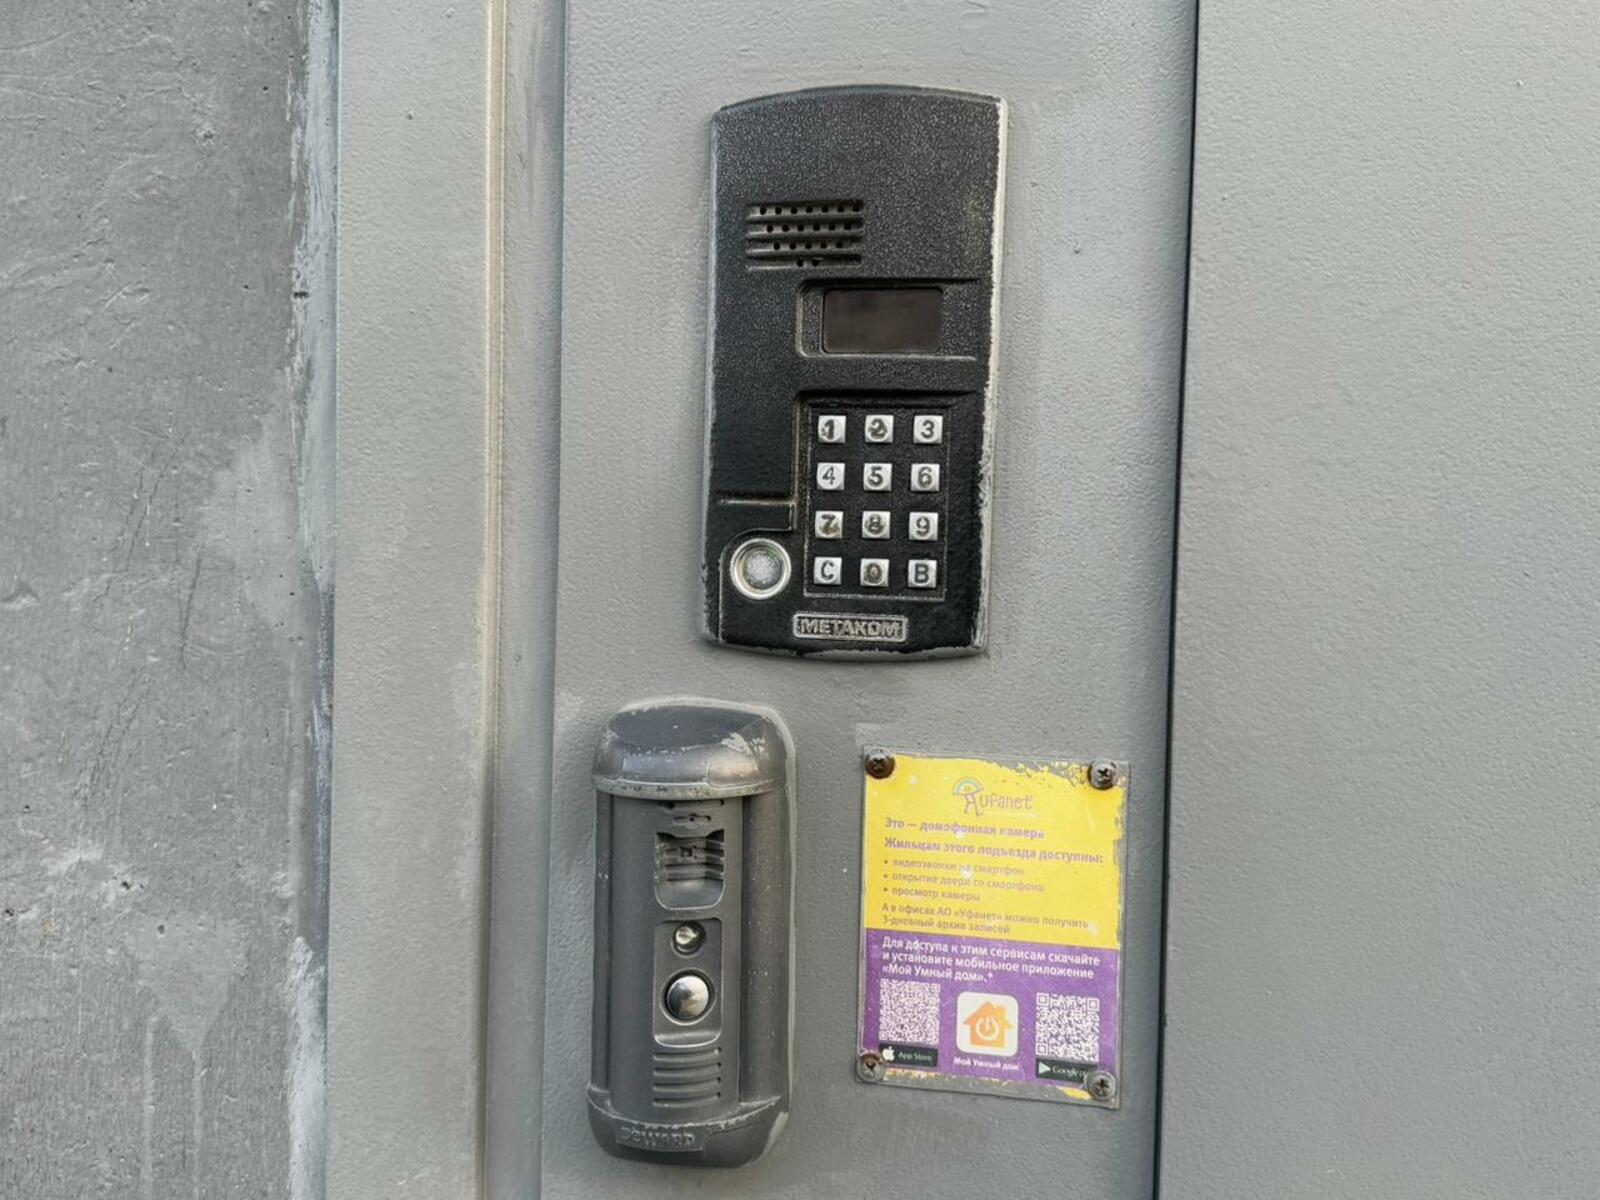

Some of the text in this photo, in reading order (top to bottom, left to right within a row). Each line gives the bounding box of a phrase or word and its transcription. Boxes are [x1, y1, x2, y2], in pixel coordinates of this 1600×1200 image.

[824, 419, 934, 440] 1 2 3
[822, 466, 932, 488] 4 5 6
[821, 514, 930, 537] 7 8 9
[821, 560, 834, 580] C
[885, 817, 904, 828] Это
[884, 838, 941, 852] Жильцам
[944, 843, 975, 855] этого
[978, 847, 1037, 859] подъезда
[892, 887, 939, 899] просмотр
[899, 904, 935, 917] офисах
[969, 921, 1010, 934] записей
[883, 936, 1100, 966] Для доступа к этим сервисам скачайте
[883, 952, 1094, 979] и установите мобильное приложение
[883, 964, 912, 976] «Мой
[914, 966, 952, 980] Умный
